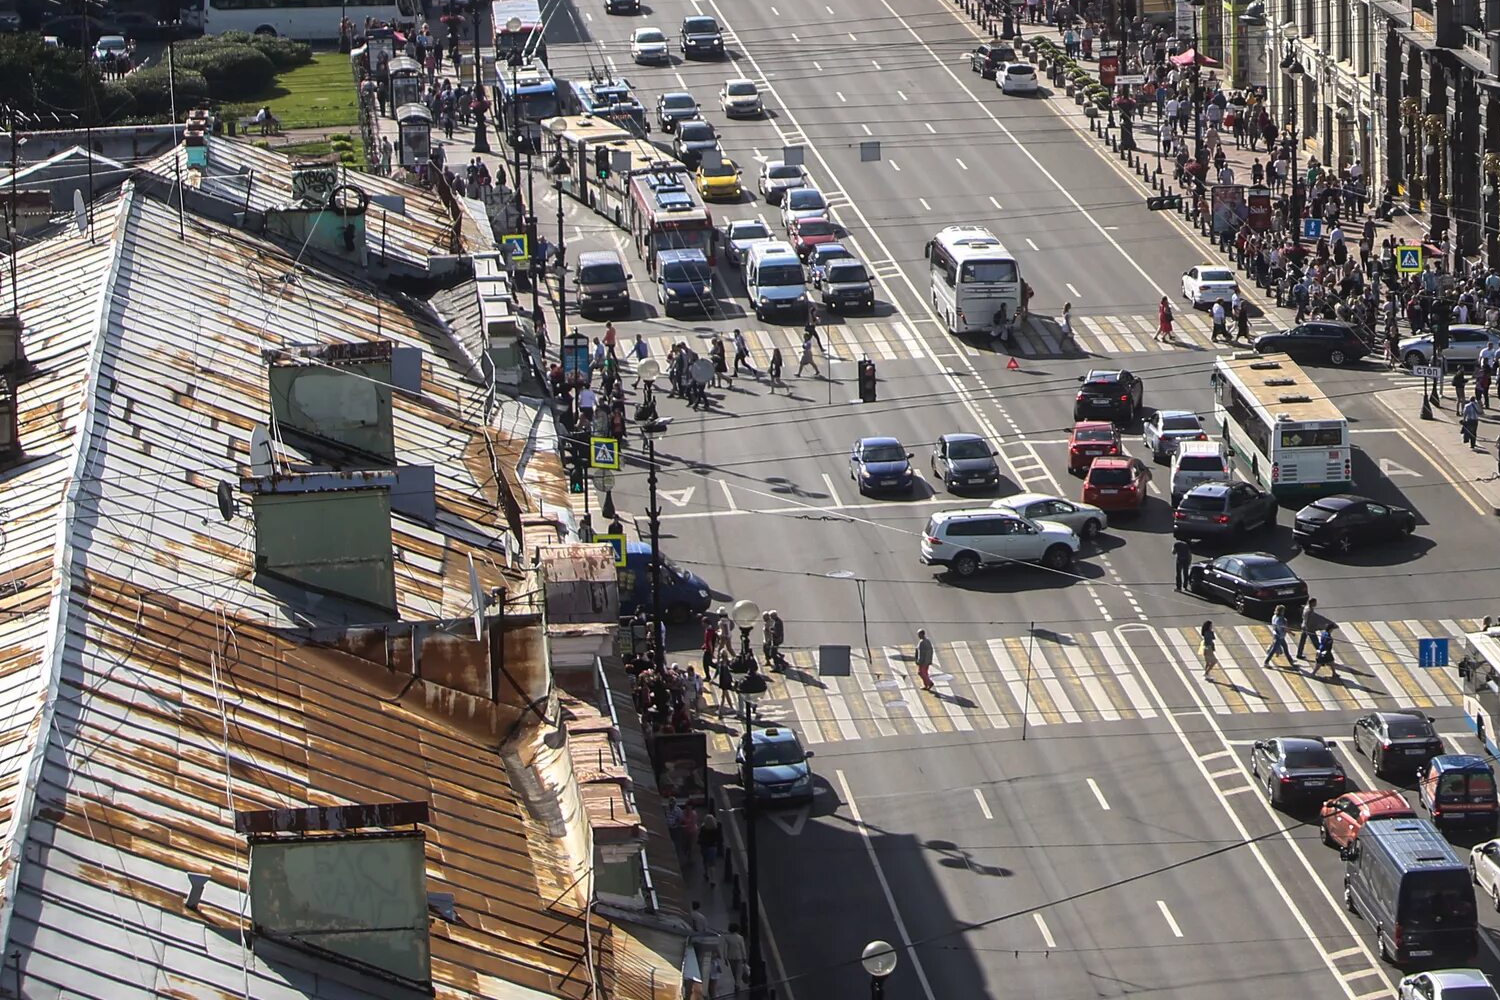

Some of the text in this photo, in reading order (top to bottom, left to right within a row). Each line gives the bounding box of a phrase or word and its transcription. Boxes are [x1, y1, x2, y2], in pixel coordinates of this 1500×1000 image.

[1102, 64, 1117, 72] Sale
[1250, 205, 1267, 214] Sale
[1416, 367, 1438, 376] СТОП
